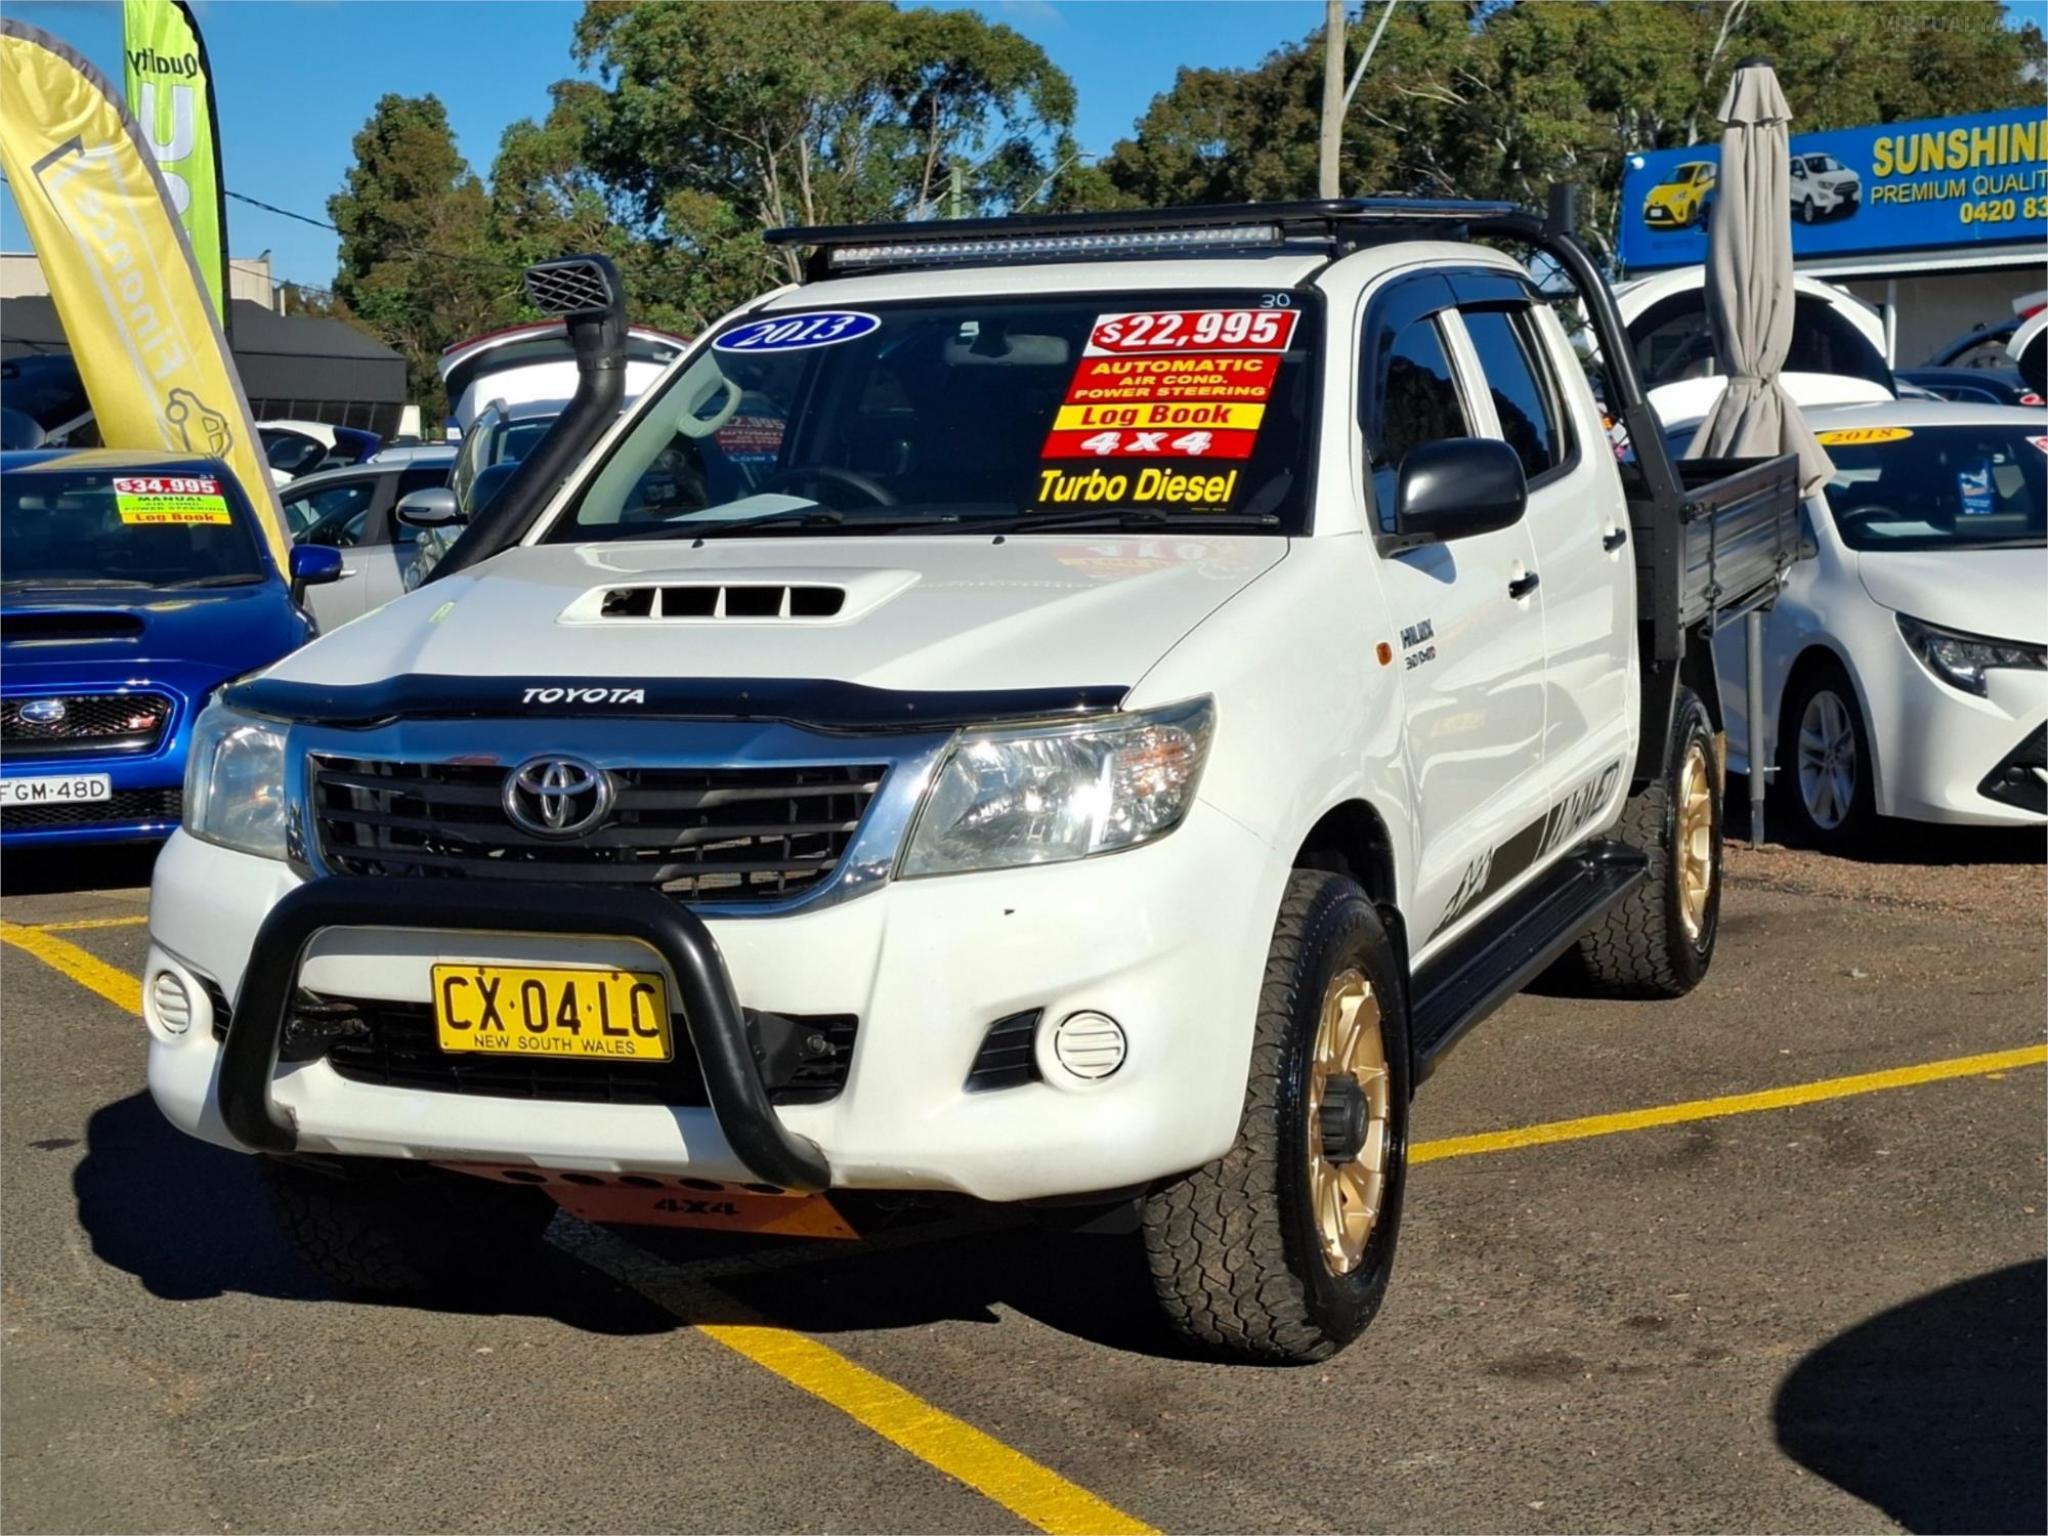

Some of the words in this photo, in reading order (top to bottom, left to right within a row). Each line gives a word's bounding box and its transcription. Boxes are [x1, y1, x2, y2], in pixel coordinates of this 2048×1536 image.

[1871, 178, 1966, 204] PREMIUM
[1960, 198, 2016, 224] 0420
[1260, 293, 1291, 309] 30
[732, 315, 857, 348] 2013
[1099, 312, 1283, 347] $22,995
[1090, 358, 1264, 375] AUTOMATIC
[1119, 376, 1156, 386] AIR
[1161, 374, 1229, 386] COND.
[1074, 387, 1150, 400] POWER
[1156, 385, 1267, 397] STEERING
[1080, 406, 1139, 427] Log
[1147, 404, 1232, 425] Book
[1830, 428, 1893, 443] 2018
[1038, 468, 1127, 503] Turbo
[1132, 467, 1238, 503] Diesel
[135, 513, 166, 523] Log
[171, 513, 215, 522] Book
[522, 687, 646, 704] TOYOTA
[474, 1034, 511, 1050] NEW
[518, 1036, 573, 1052] SOUTH
[580, 1038, 637, 1055] WALES
